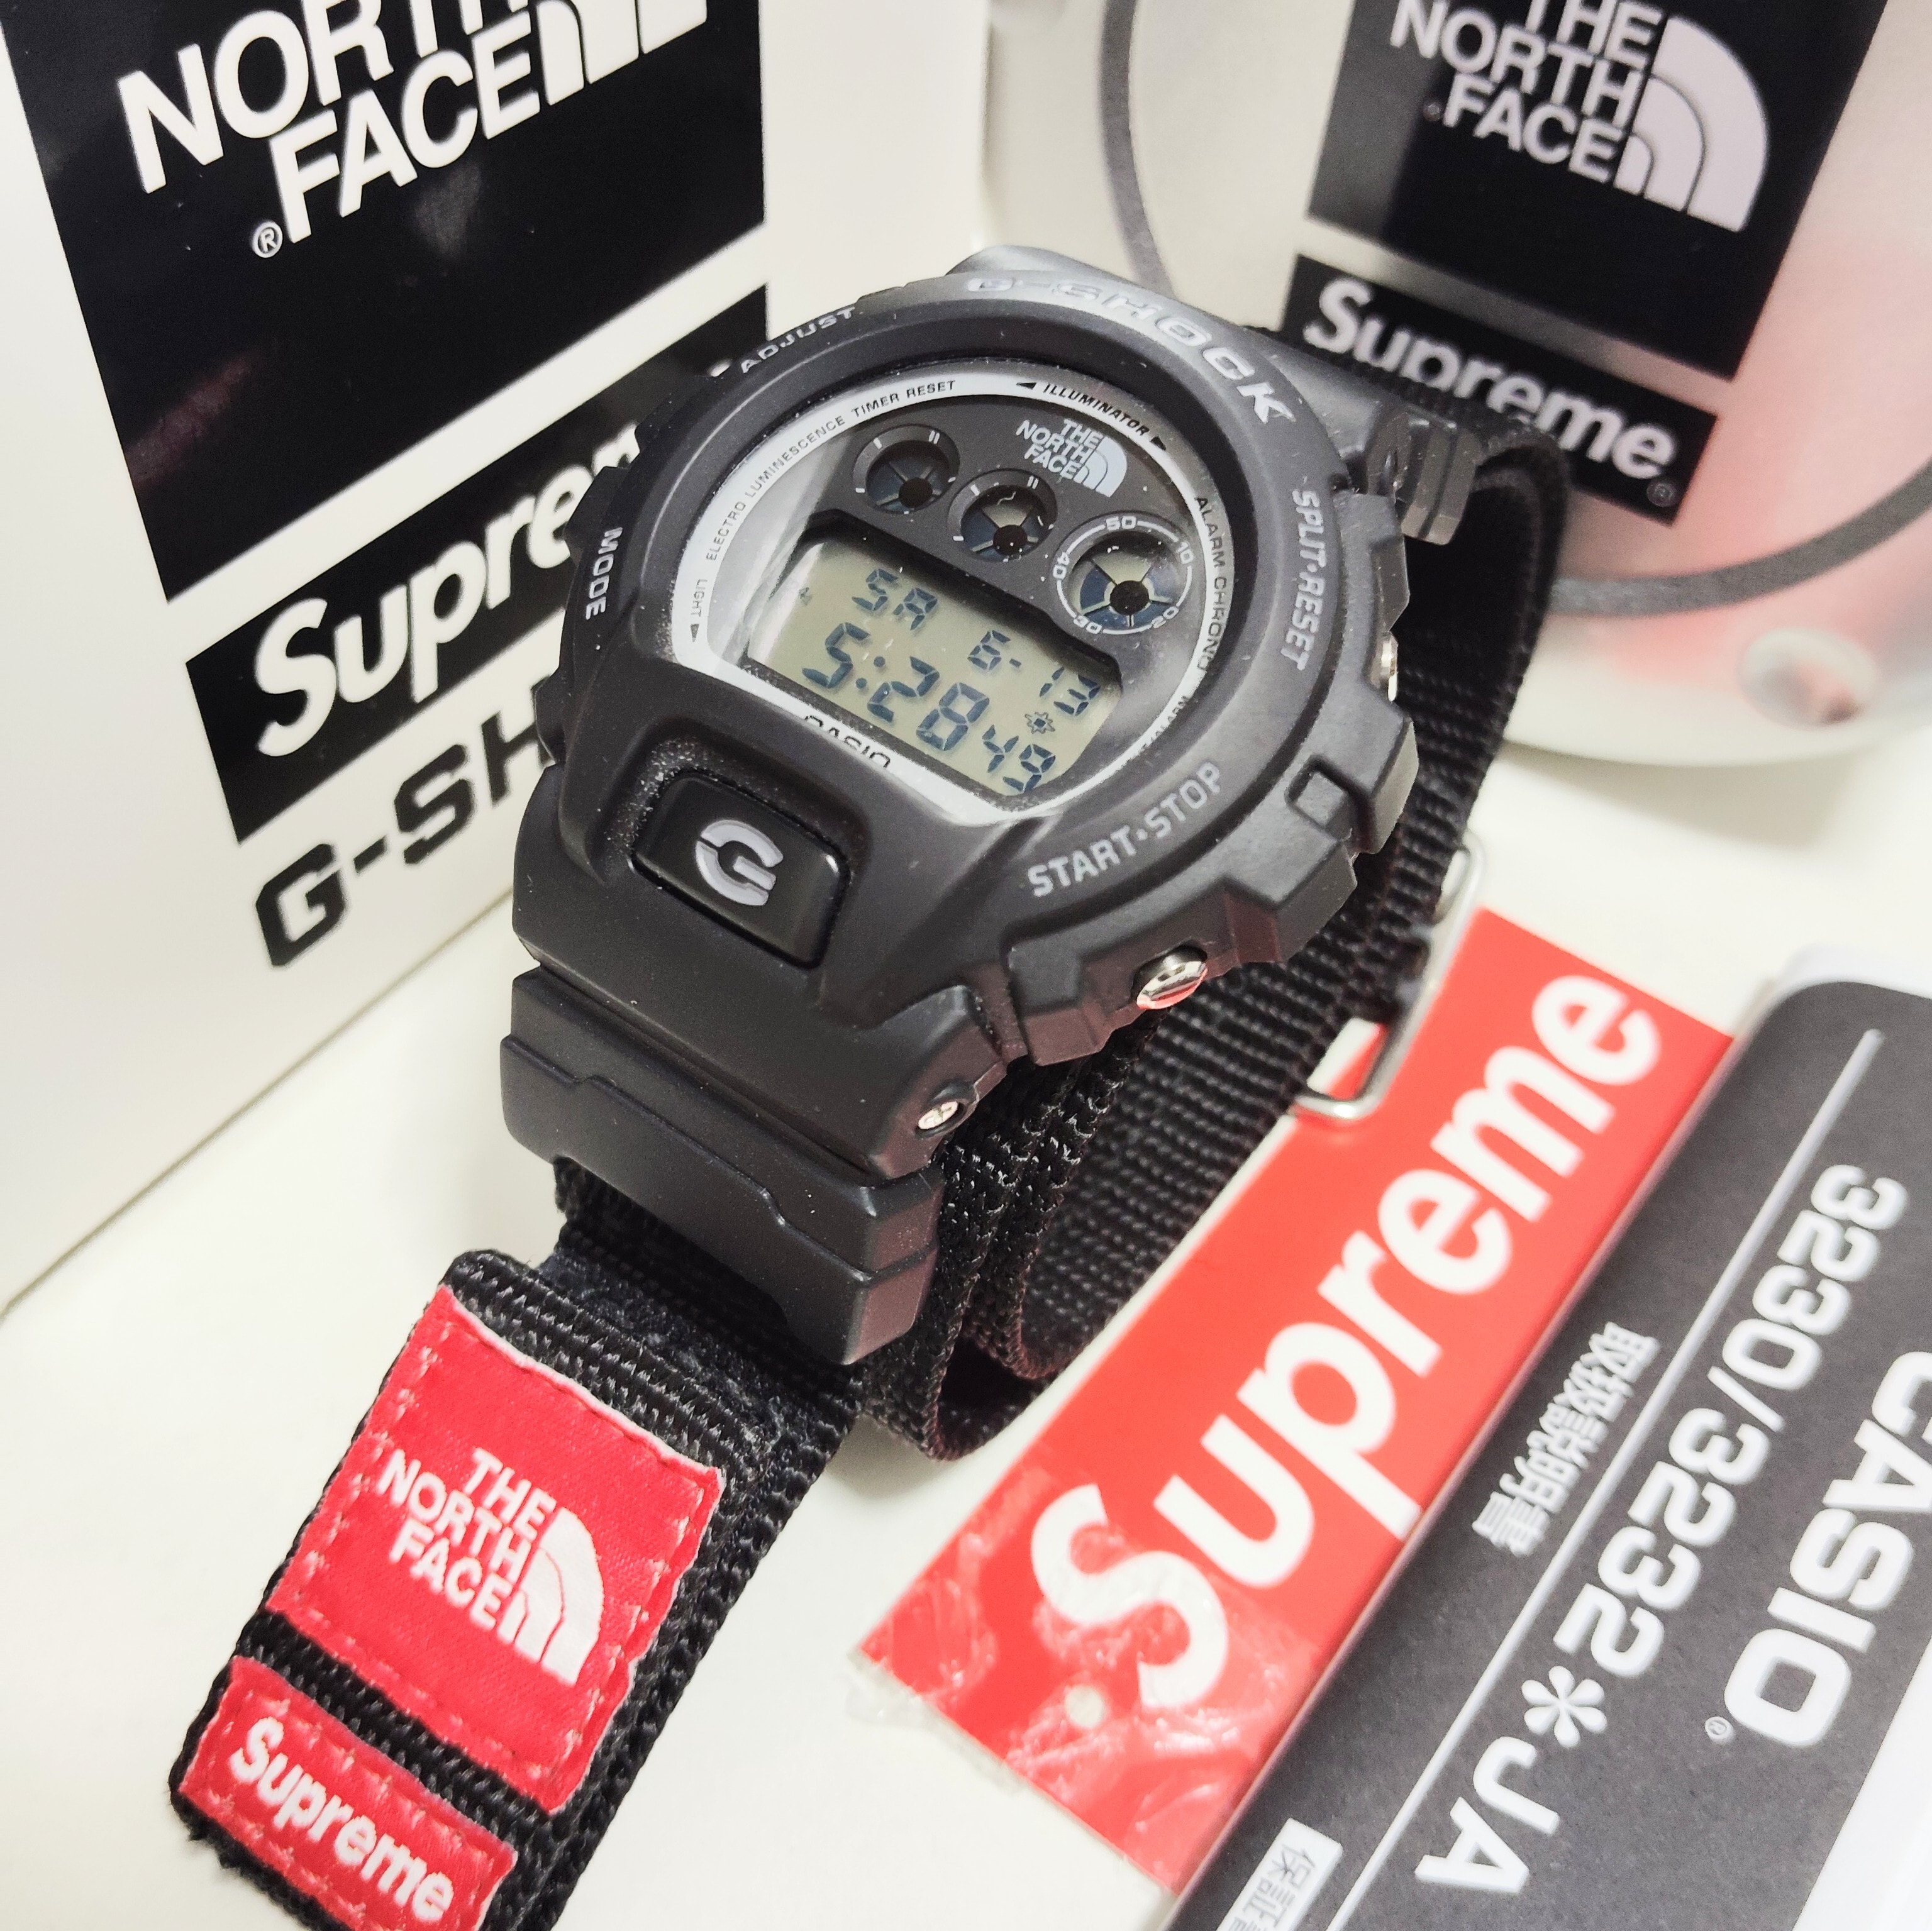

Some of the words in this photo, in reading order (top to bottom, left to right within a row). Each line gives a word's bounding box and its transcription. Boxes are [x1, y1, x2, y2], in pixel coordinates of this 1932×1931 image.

[117, 0, 528, 194] NOR
[1390, 0, 1644, 128] NORTH
[269, 11, 541, 244] FACE
[1443, 72, 1624, 184] FACE
[741, 306, 855, 373] ADJUST
[966, 277, 1296, 424] G-SHOCK
[1303, 279, 1675, 479] Supreme
[852, 393, 900, 418] TIMER
[906, 380, 956, 398] RESET
[1016, 419, 1091, 463] NORTH
[1043, 384, 1150, 436] ILLUMINATOR
[1061, 419, 1102, 450] THE
[706, 501, 746, 562] ELECTRO
[745, 416, 846, 498] LUMINESCENCE
[1024, 445, 1082, 481] FACE
[1053, 551, 1070, 580] 40
[1105, 516, 1136, 531] 50
[1177, 541, 1194, 564] 10
[1195, 496, 1226, 568] ALARM
[586, 526, 623, 621] MODE
[691, 577, 708, 617] LIGHT
[1152, 607, 1179, 628] 20
[1073, 615, 1102, 634] 30
[802, 622, 990, 752] 5:28
[1031, 975, 1661, 1710] Supreme
[1472, 1322, 1661, 1558] 取扱説明書
[379, 1449, 535, 1576] NORTH
[470, 1447, 557, 1539] THE
[389, 1523, 514, 1629] FACE
[229, 1716, 455, 1923] Supreme
